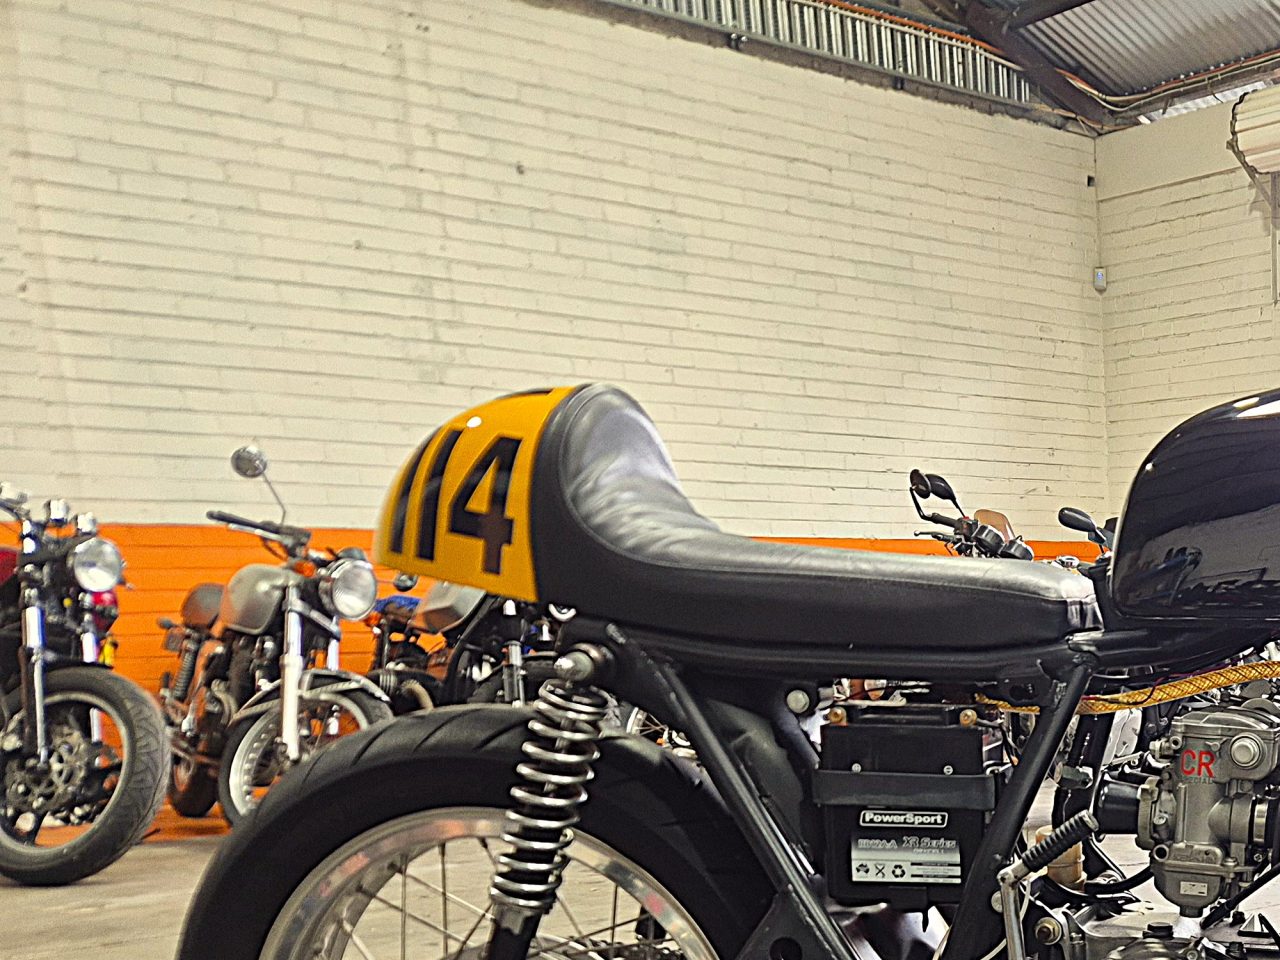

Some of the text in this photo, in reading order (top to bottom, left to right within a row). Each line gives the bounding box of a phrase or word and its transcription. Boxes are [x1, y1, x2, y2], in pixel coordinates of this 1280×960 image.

[390, 425, 524, 576] 114
[1180, 748, 1217, 779] CR
[864, 811, 943, 825] PowerSport
[920, 836, 957, 849] Series
